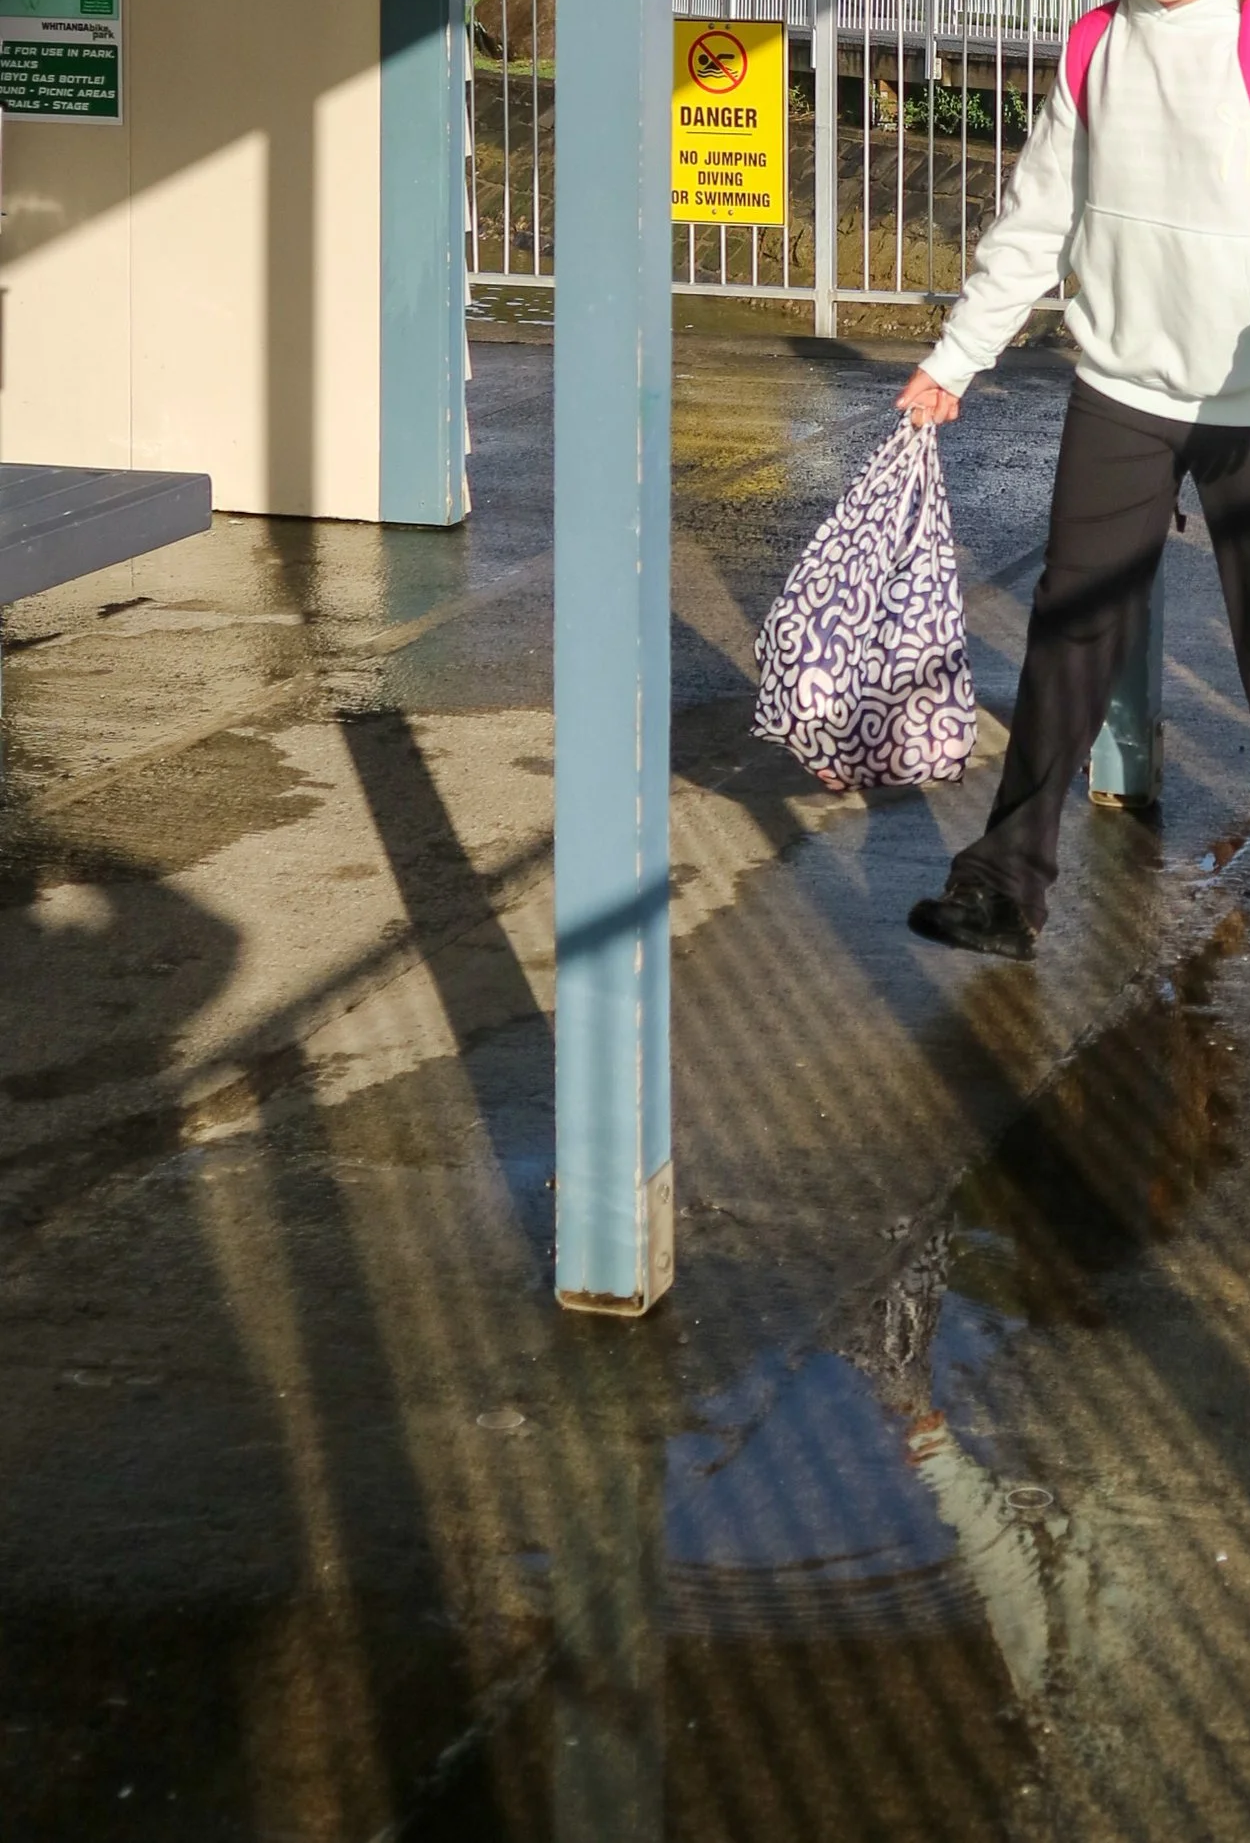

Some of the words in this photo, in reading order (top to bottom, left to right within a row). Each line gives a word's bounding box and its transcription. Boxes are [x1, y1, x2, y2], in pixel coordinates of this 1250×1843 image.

[15, 47, 37, 56] FOR
[41, 48, 64, 57] USE
[67, 49, 79, 57] IN
[82, 49, 115, 58] PARK.
[0, 60, 39, 69] WALKS
[32, 74, 55, 83] GAS
[38, 87, 74, 97] PICNIC
[77, 89, 116, 99] AREAS
[6, 99, 40, 109] RAILS
[52, 100, 90, 111] STAGE
[680, 106, 757, 128] DANGER
[680, 150, 698, 165] NO
[704, 151, 767, 167] JUMPING
[698, 171, 743, 186] DIVING
[672, 190, 689, 204] OR
[695, 191, 770, 207] SWIMMING
